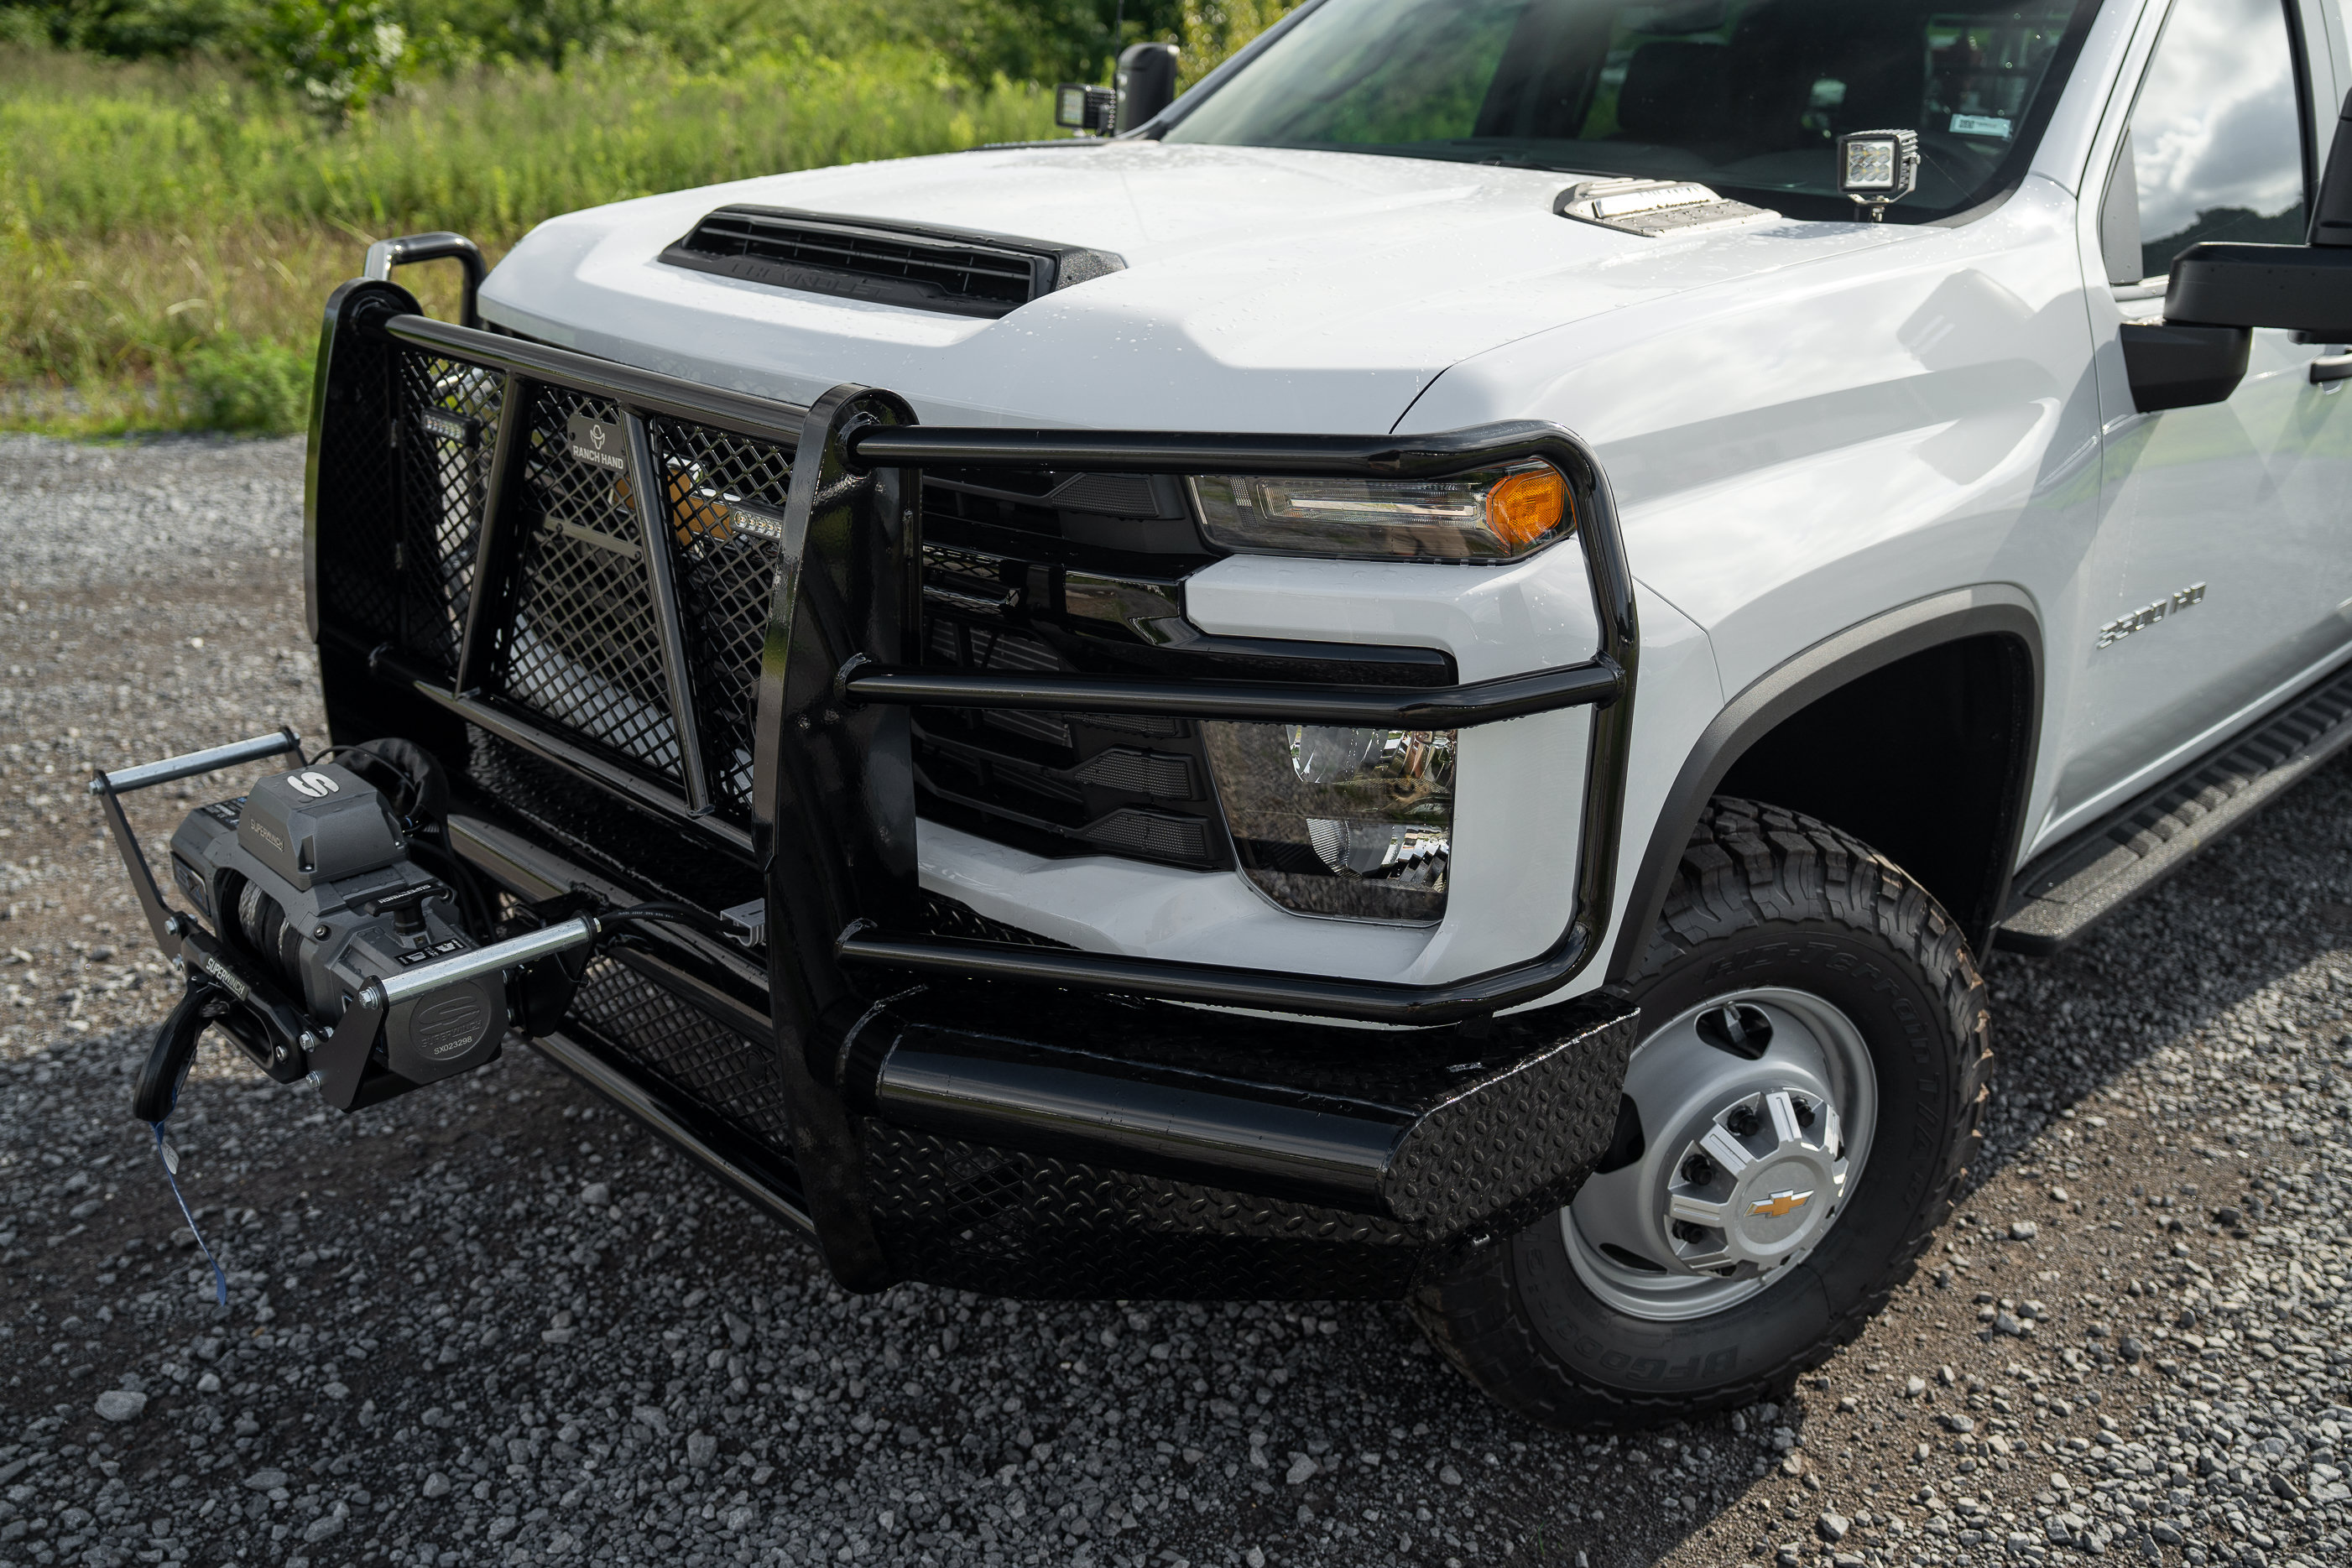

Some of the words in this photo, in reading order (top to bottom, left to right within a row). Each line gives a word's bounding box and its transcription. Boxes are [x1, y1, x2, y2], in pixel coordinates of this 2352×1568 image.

[572, 445, 600, 464] RANCH
[601, 453, 623, 470] HAND
[2096, 598, 2167, 650] 3500
[2169, 581, 2207, 616] HD
[250, 818, 284, 851] SUPERWINCH
[206, 957, 245, 996] SUPERWINCH
[421, 1019, 482, 1048] SUPERWINCH
[434, 1035, 473, 1055] SX023298
